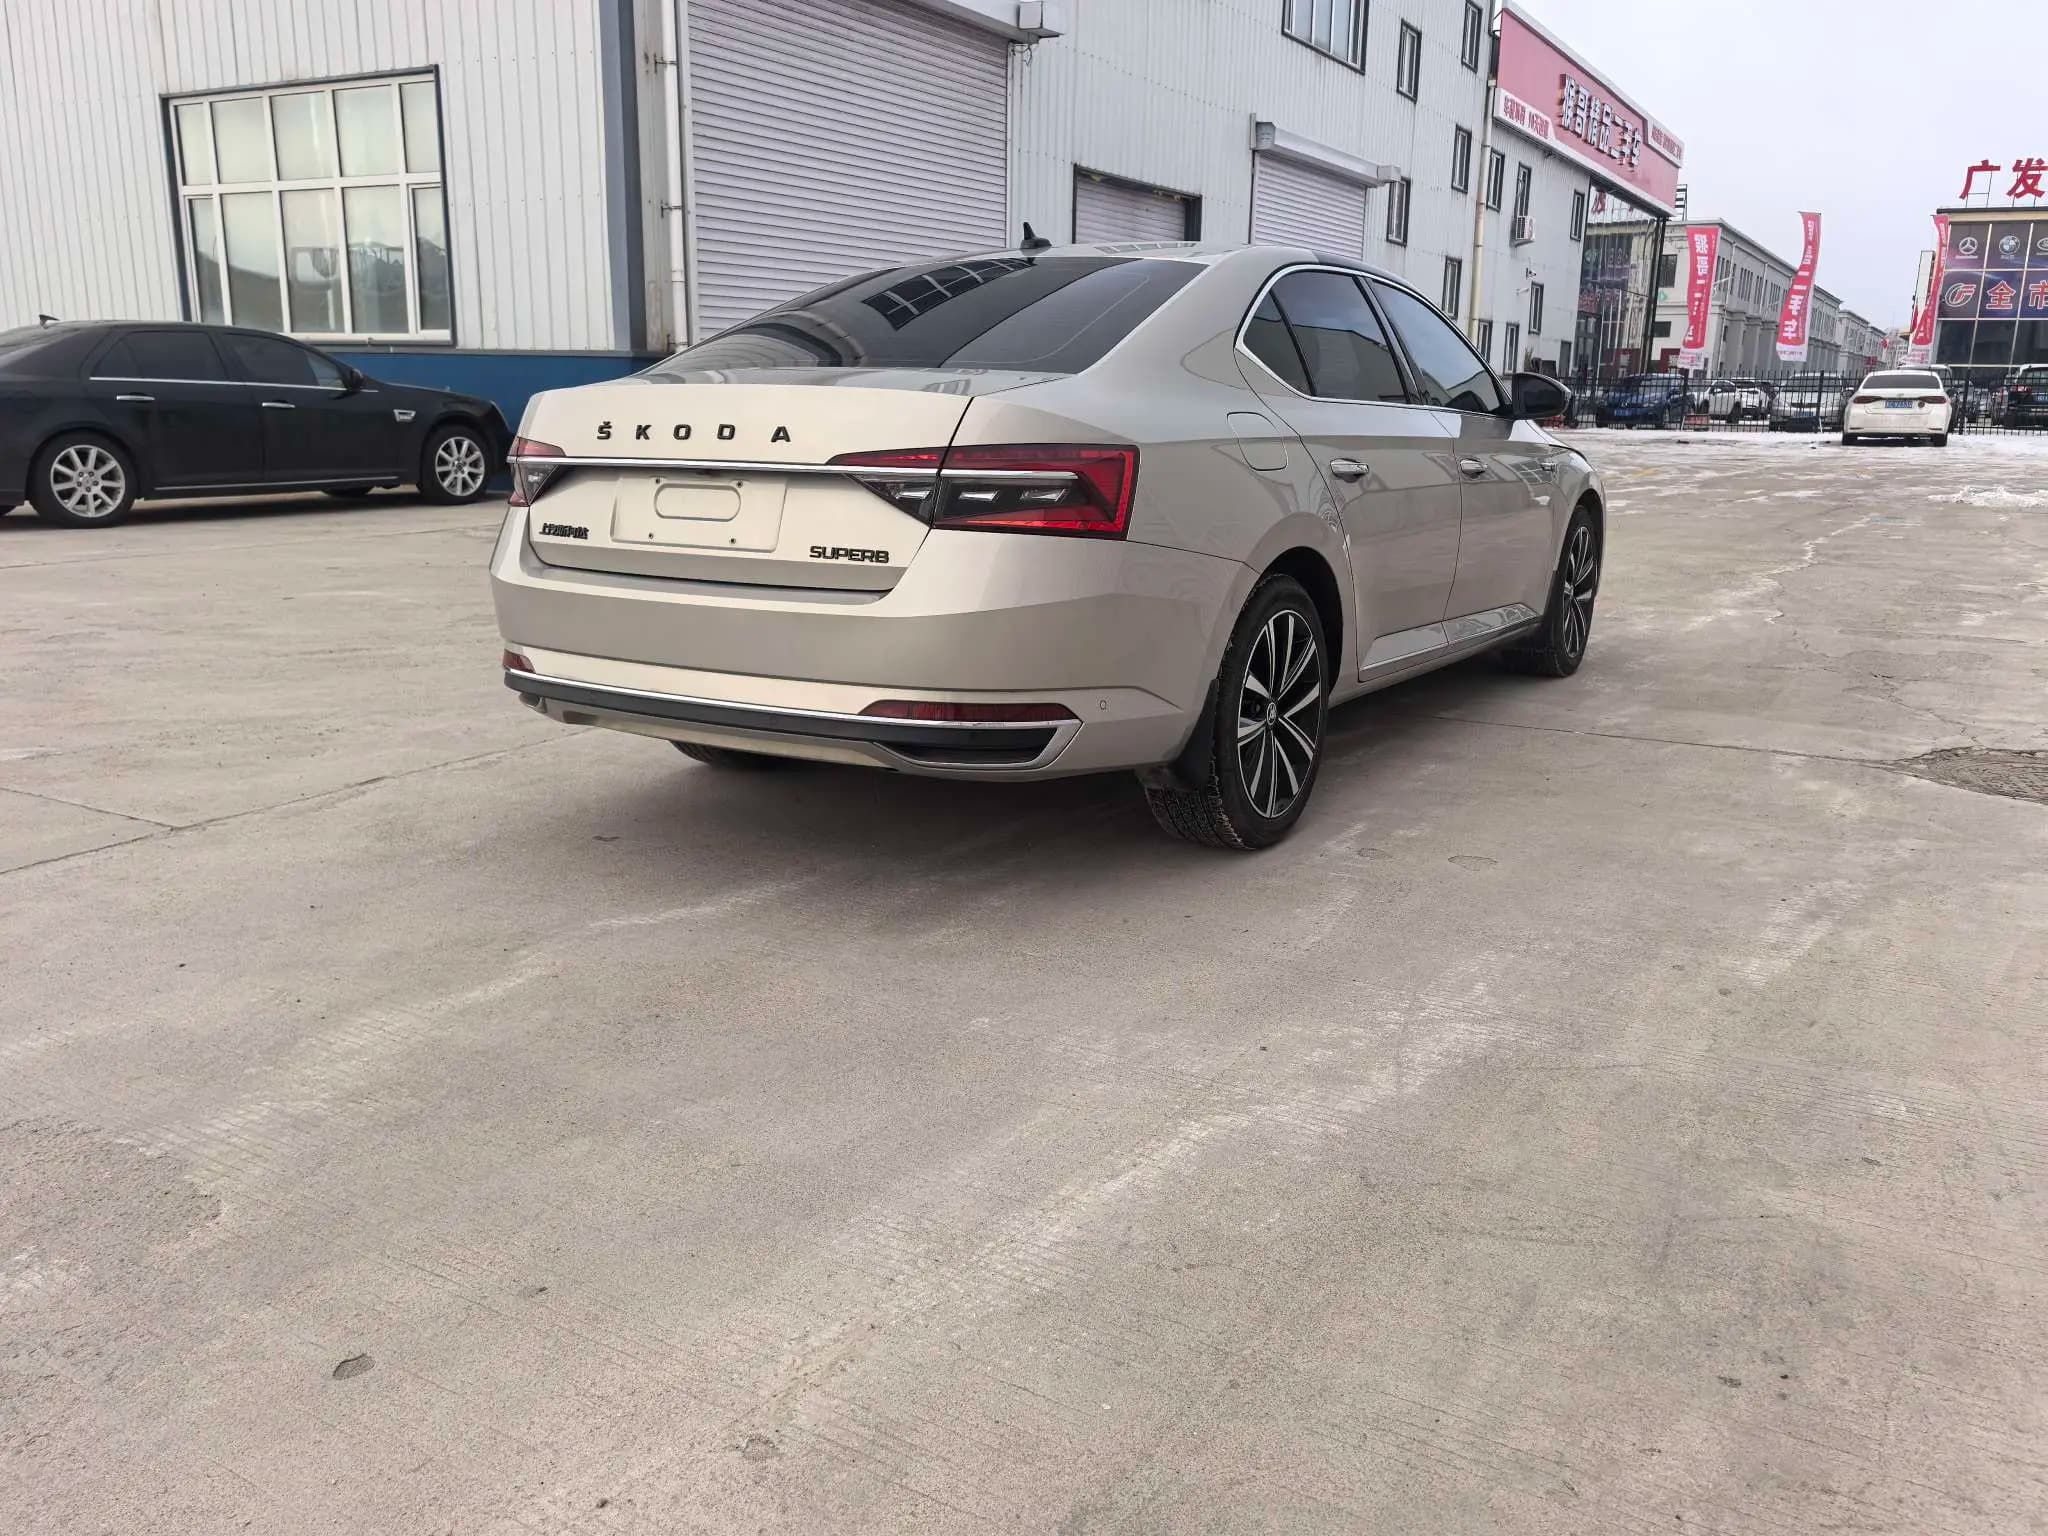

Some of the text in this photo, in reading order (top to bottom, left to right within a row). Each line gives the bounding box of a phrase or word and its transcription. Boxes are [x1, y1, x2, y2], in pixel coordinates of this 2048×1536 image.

[1959, 158, 2048, 199] 广发
[597, 421, 791, 443] ŠKODA
[809, 545, 890, 564] SUPERB
